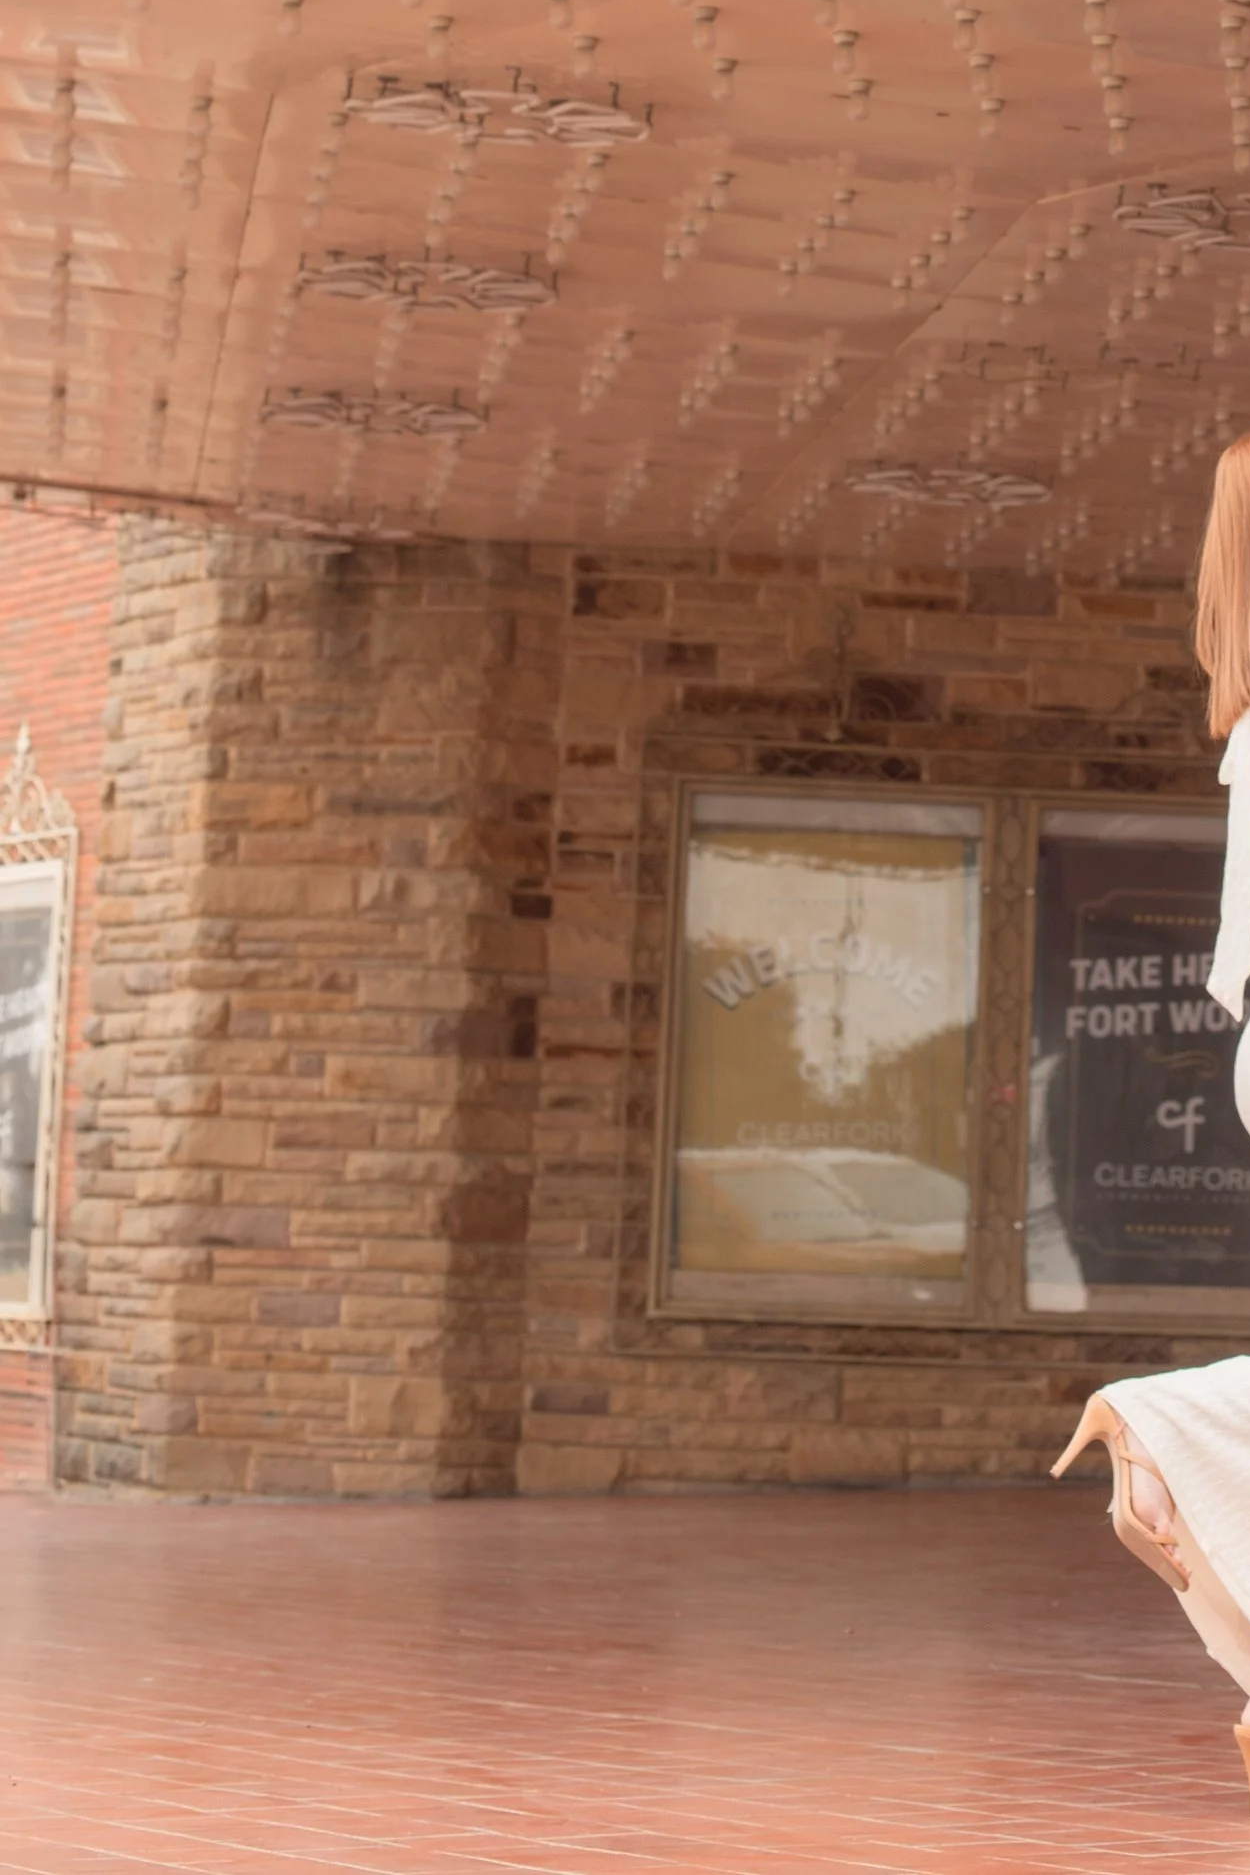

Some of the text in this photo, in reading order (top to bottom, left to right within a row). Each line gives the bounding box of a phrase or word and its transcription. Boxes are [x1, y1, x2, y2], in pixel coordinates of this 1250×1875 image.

[702, 931, 942, 1012] WELCOME
[1069, 954, 1164, 992] TAKE
[1065, 1002, 1160, 1040] FORT
